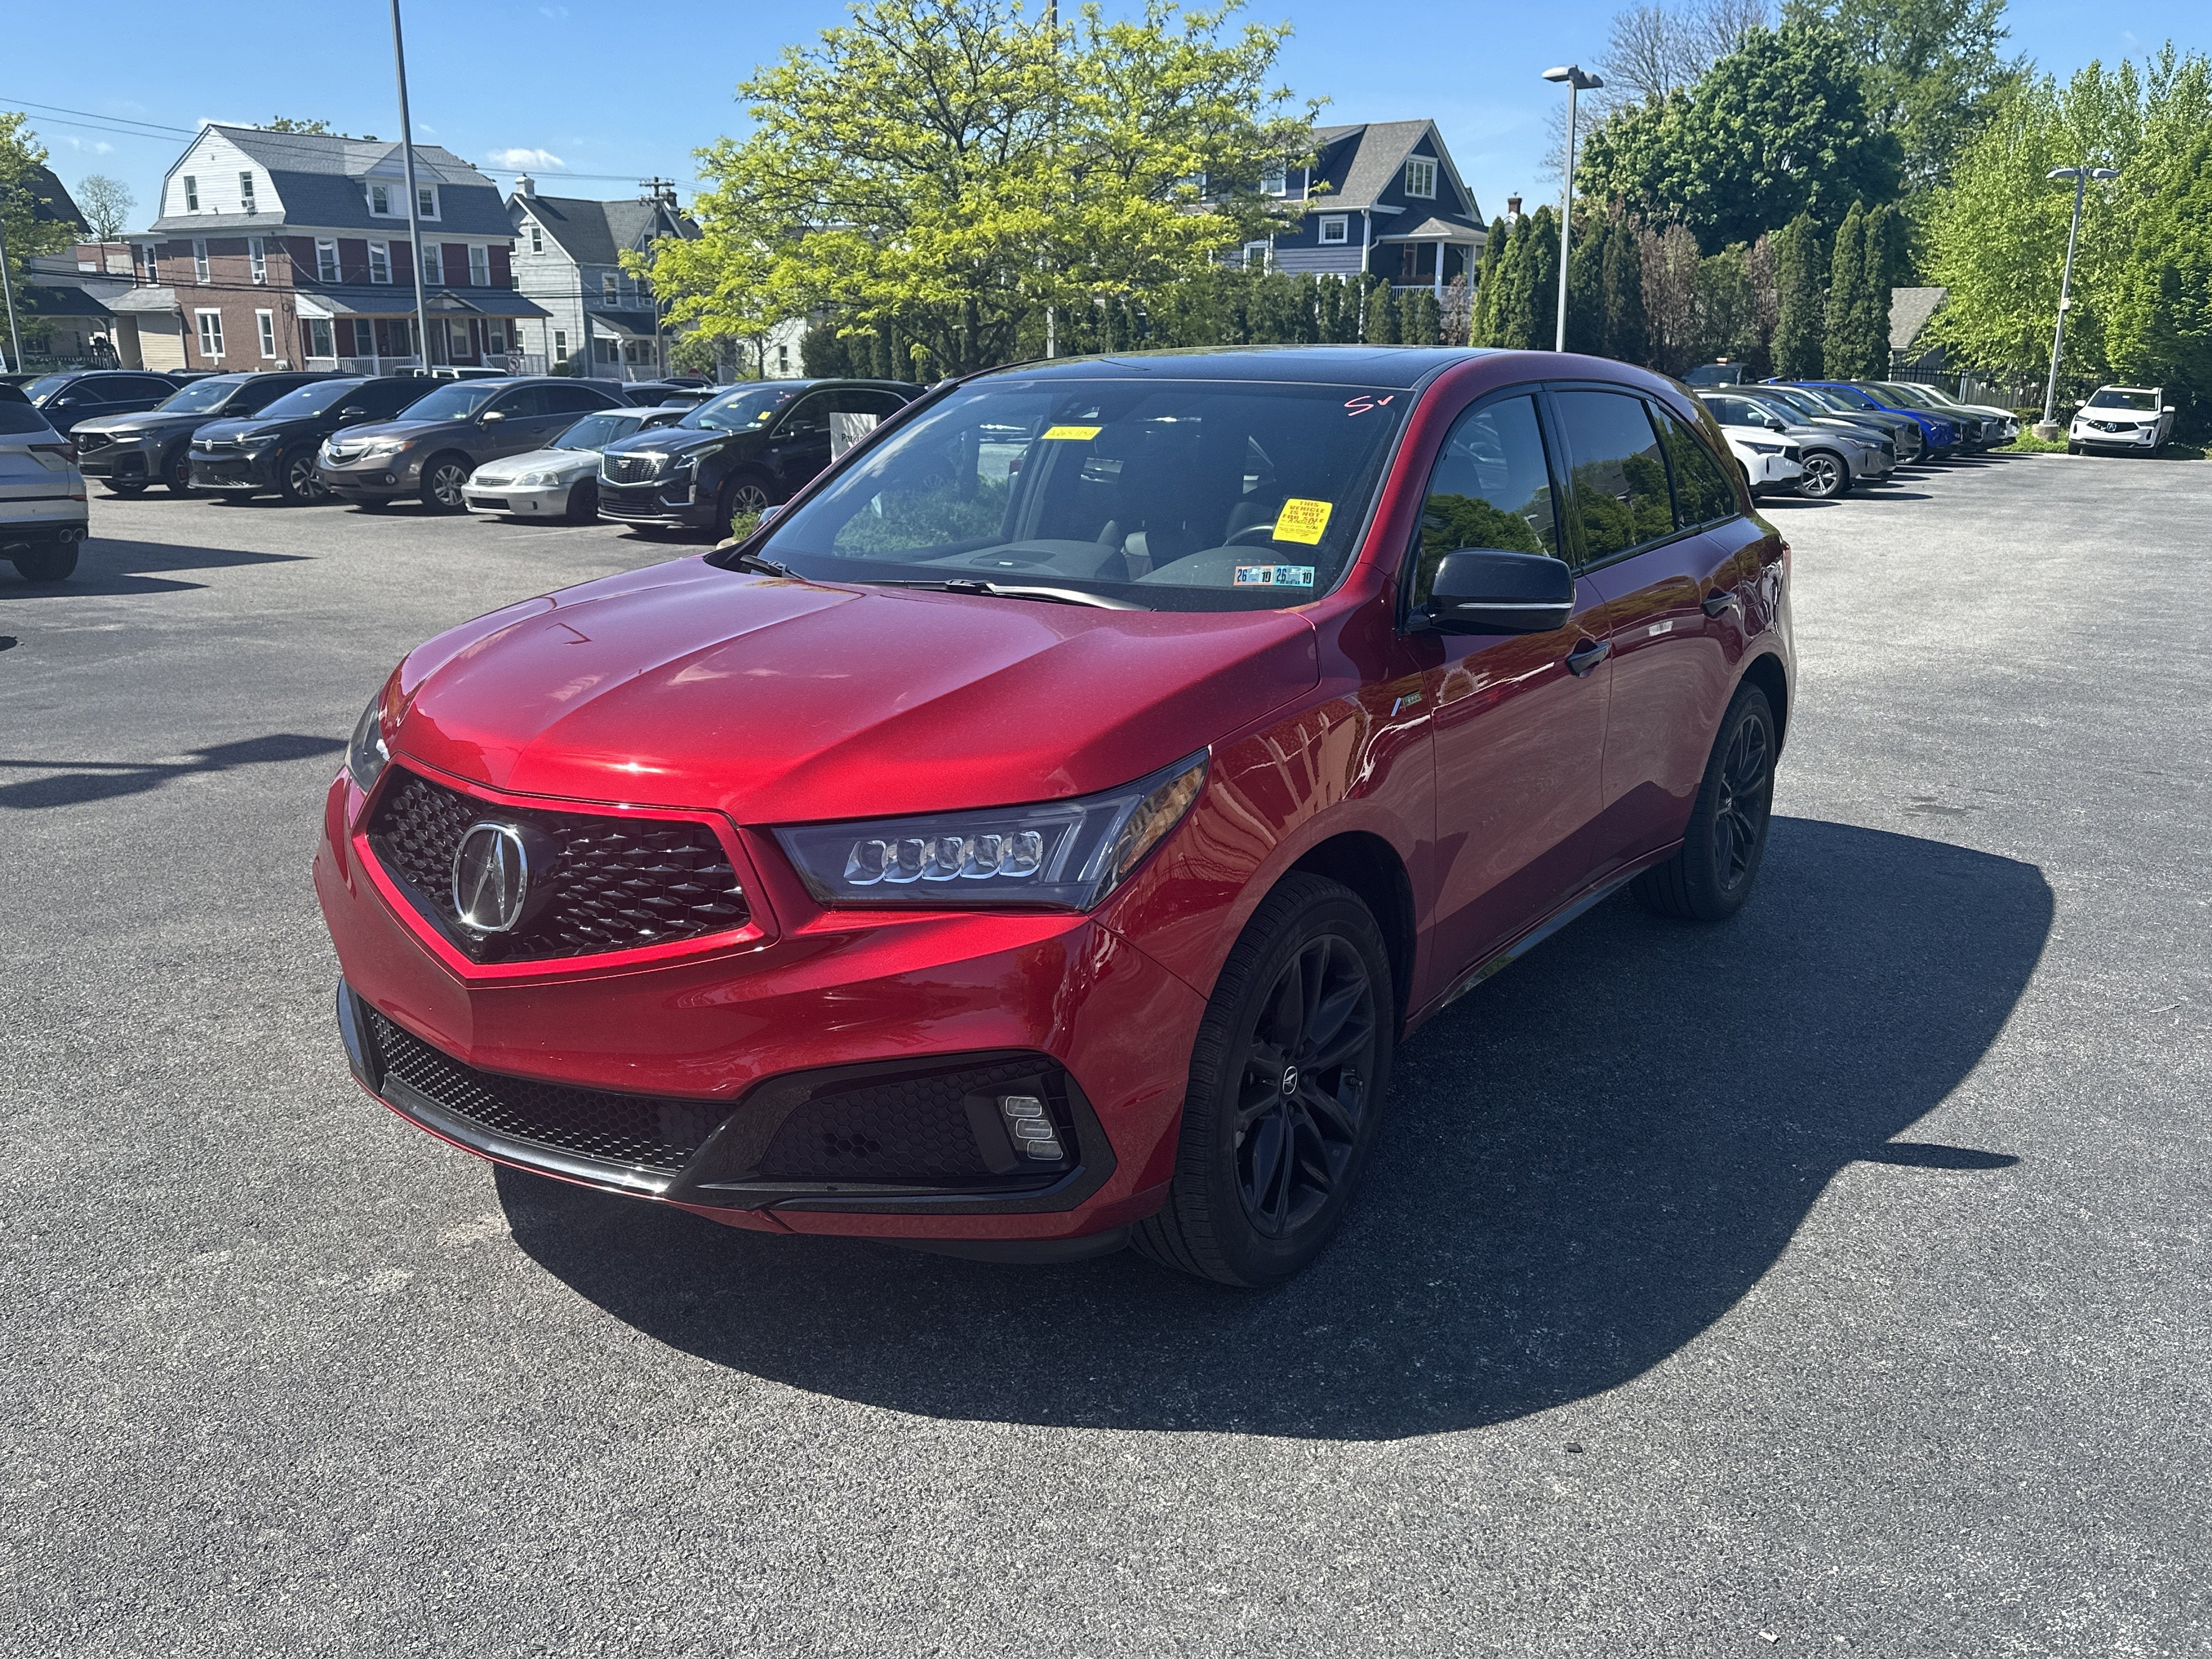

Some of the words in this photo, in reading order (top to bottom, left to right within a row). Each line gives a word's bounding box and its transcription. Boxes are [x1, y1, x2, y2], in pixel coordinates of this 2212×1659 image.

[1290, 505, 1326, 514] VEHICLE
[1237, 568, 1247, 583] 26
[1262, 571, 1271, 582] 10
[1277, 568, 1286, 582] 26
[1302, 572, 1312, 584] 10
